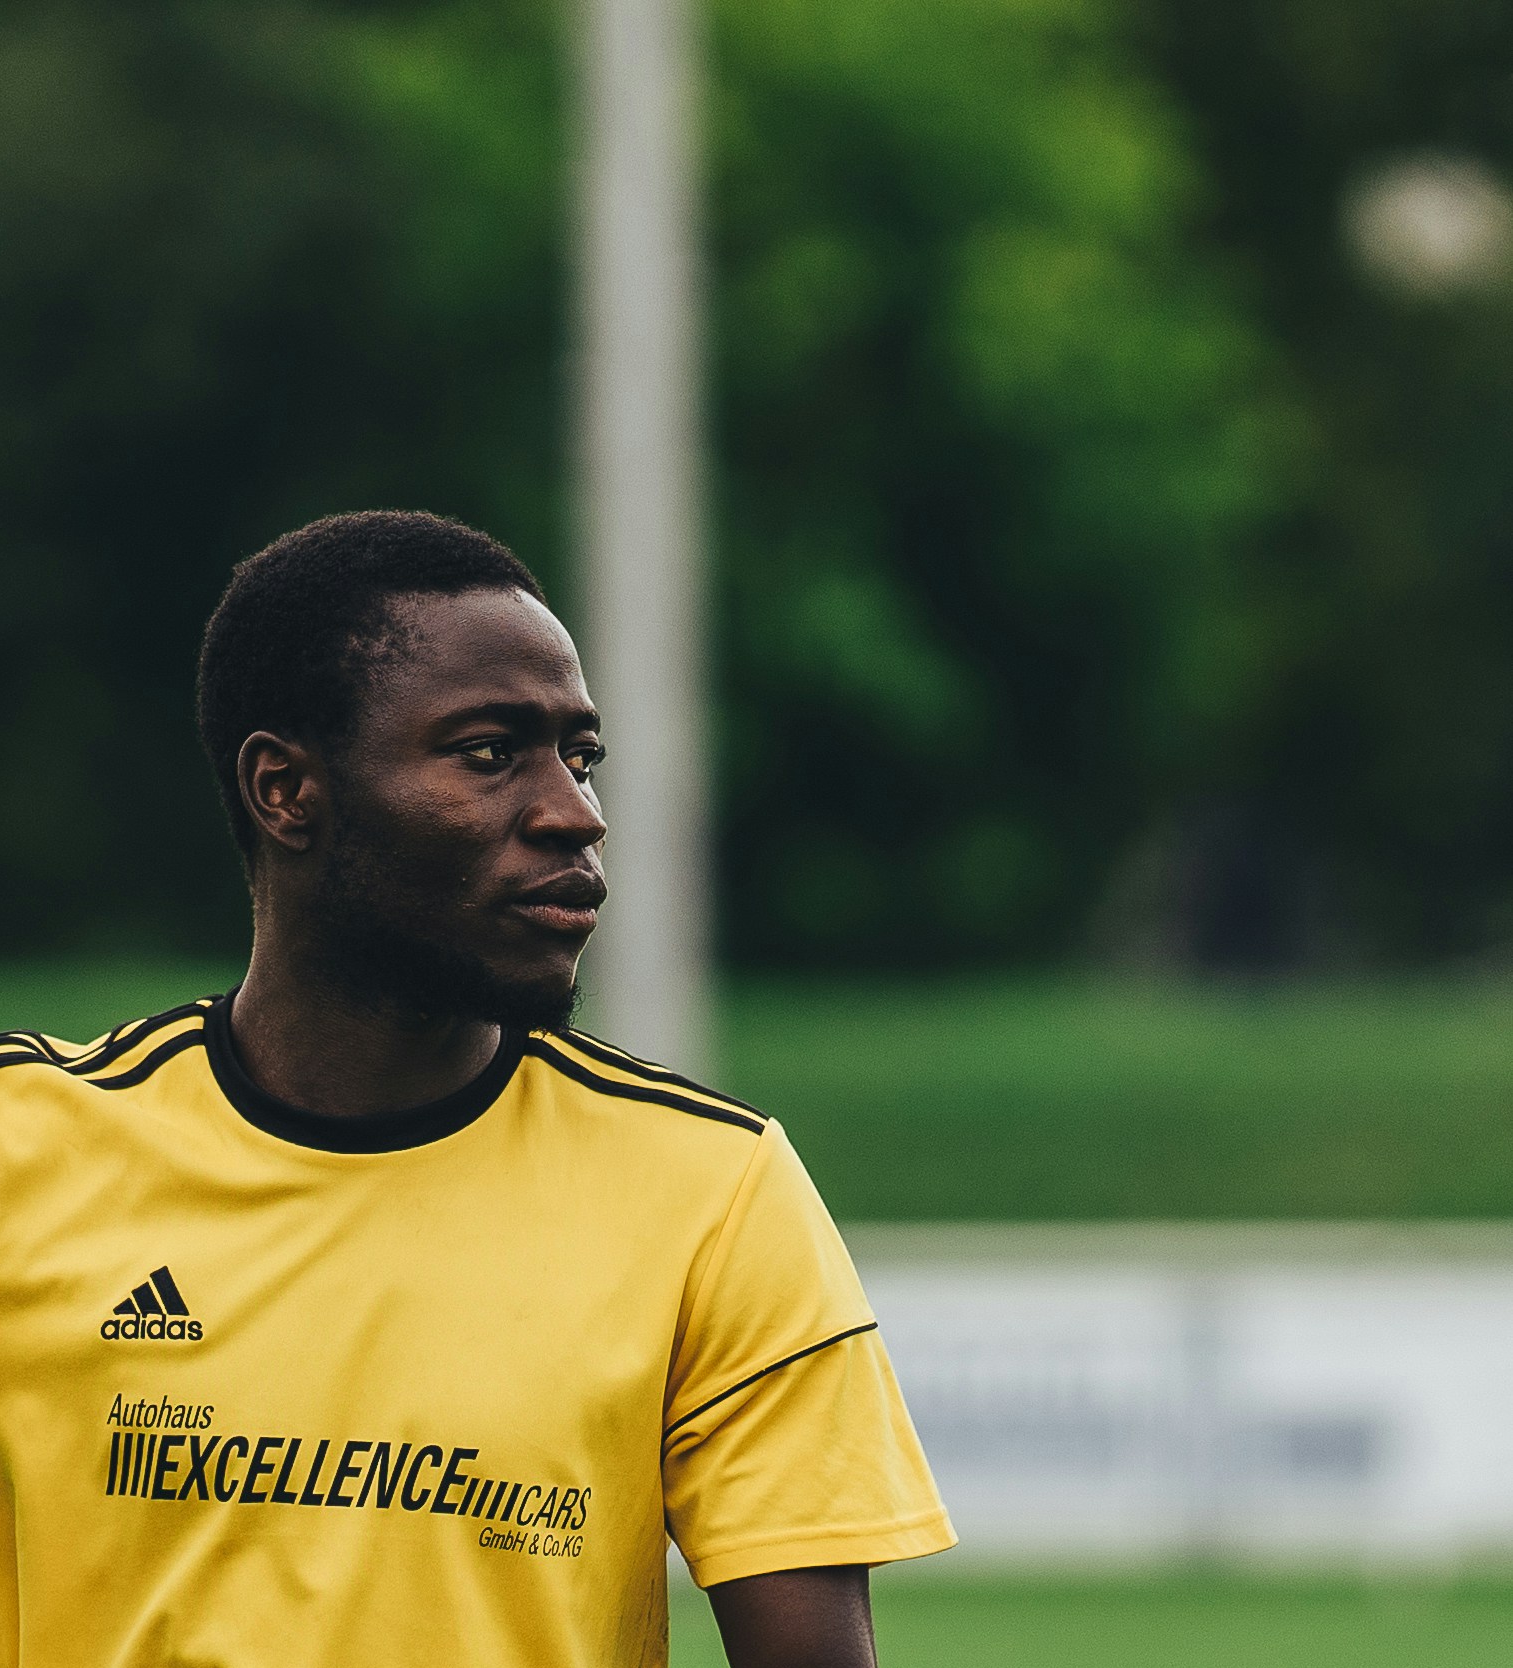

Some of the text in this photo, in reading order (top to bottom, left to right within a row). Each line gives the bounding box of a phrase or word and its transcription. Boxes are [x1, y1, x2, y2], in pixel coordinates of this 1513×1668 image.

[100, 1313, 204, 1341] adidas
[106, 1393, 215, 1430] Autohaus
[150, 1434, 592, 1531] EXCELLENCE CARS
[478, 1526, 584, 1558] GmbH & Co.KG
